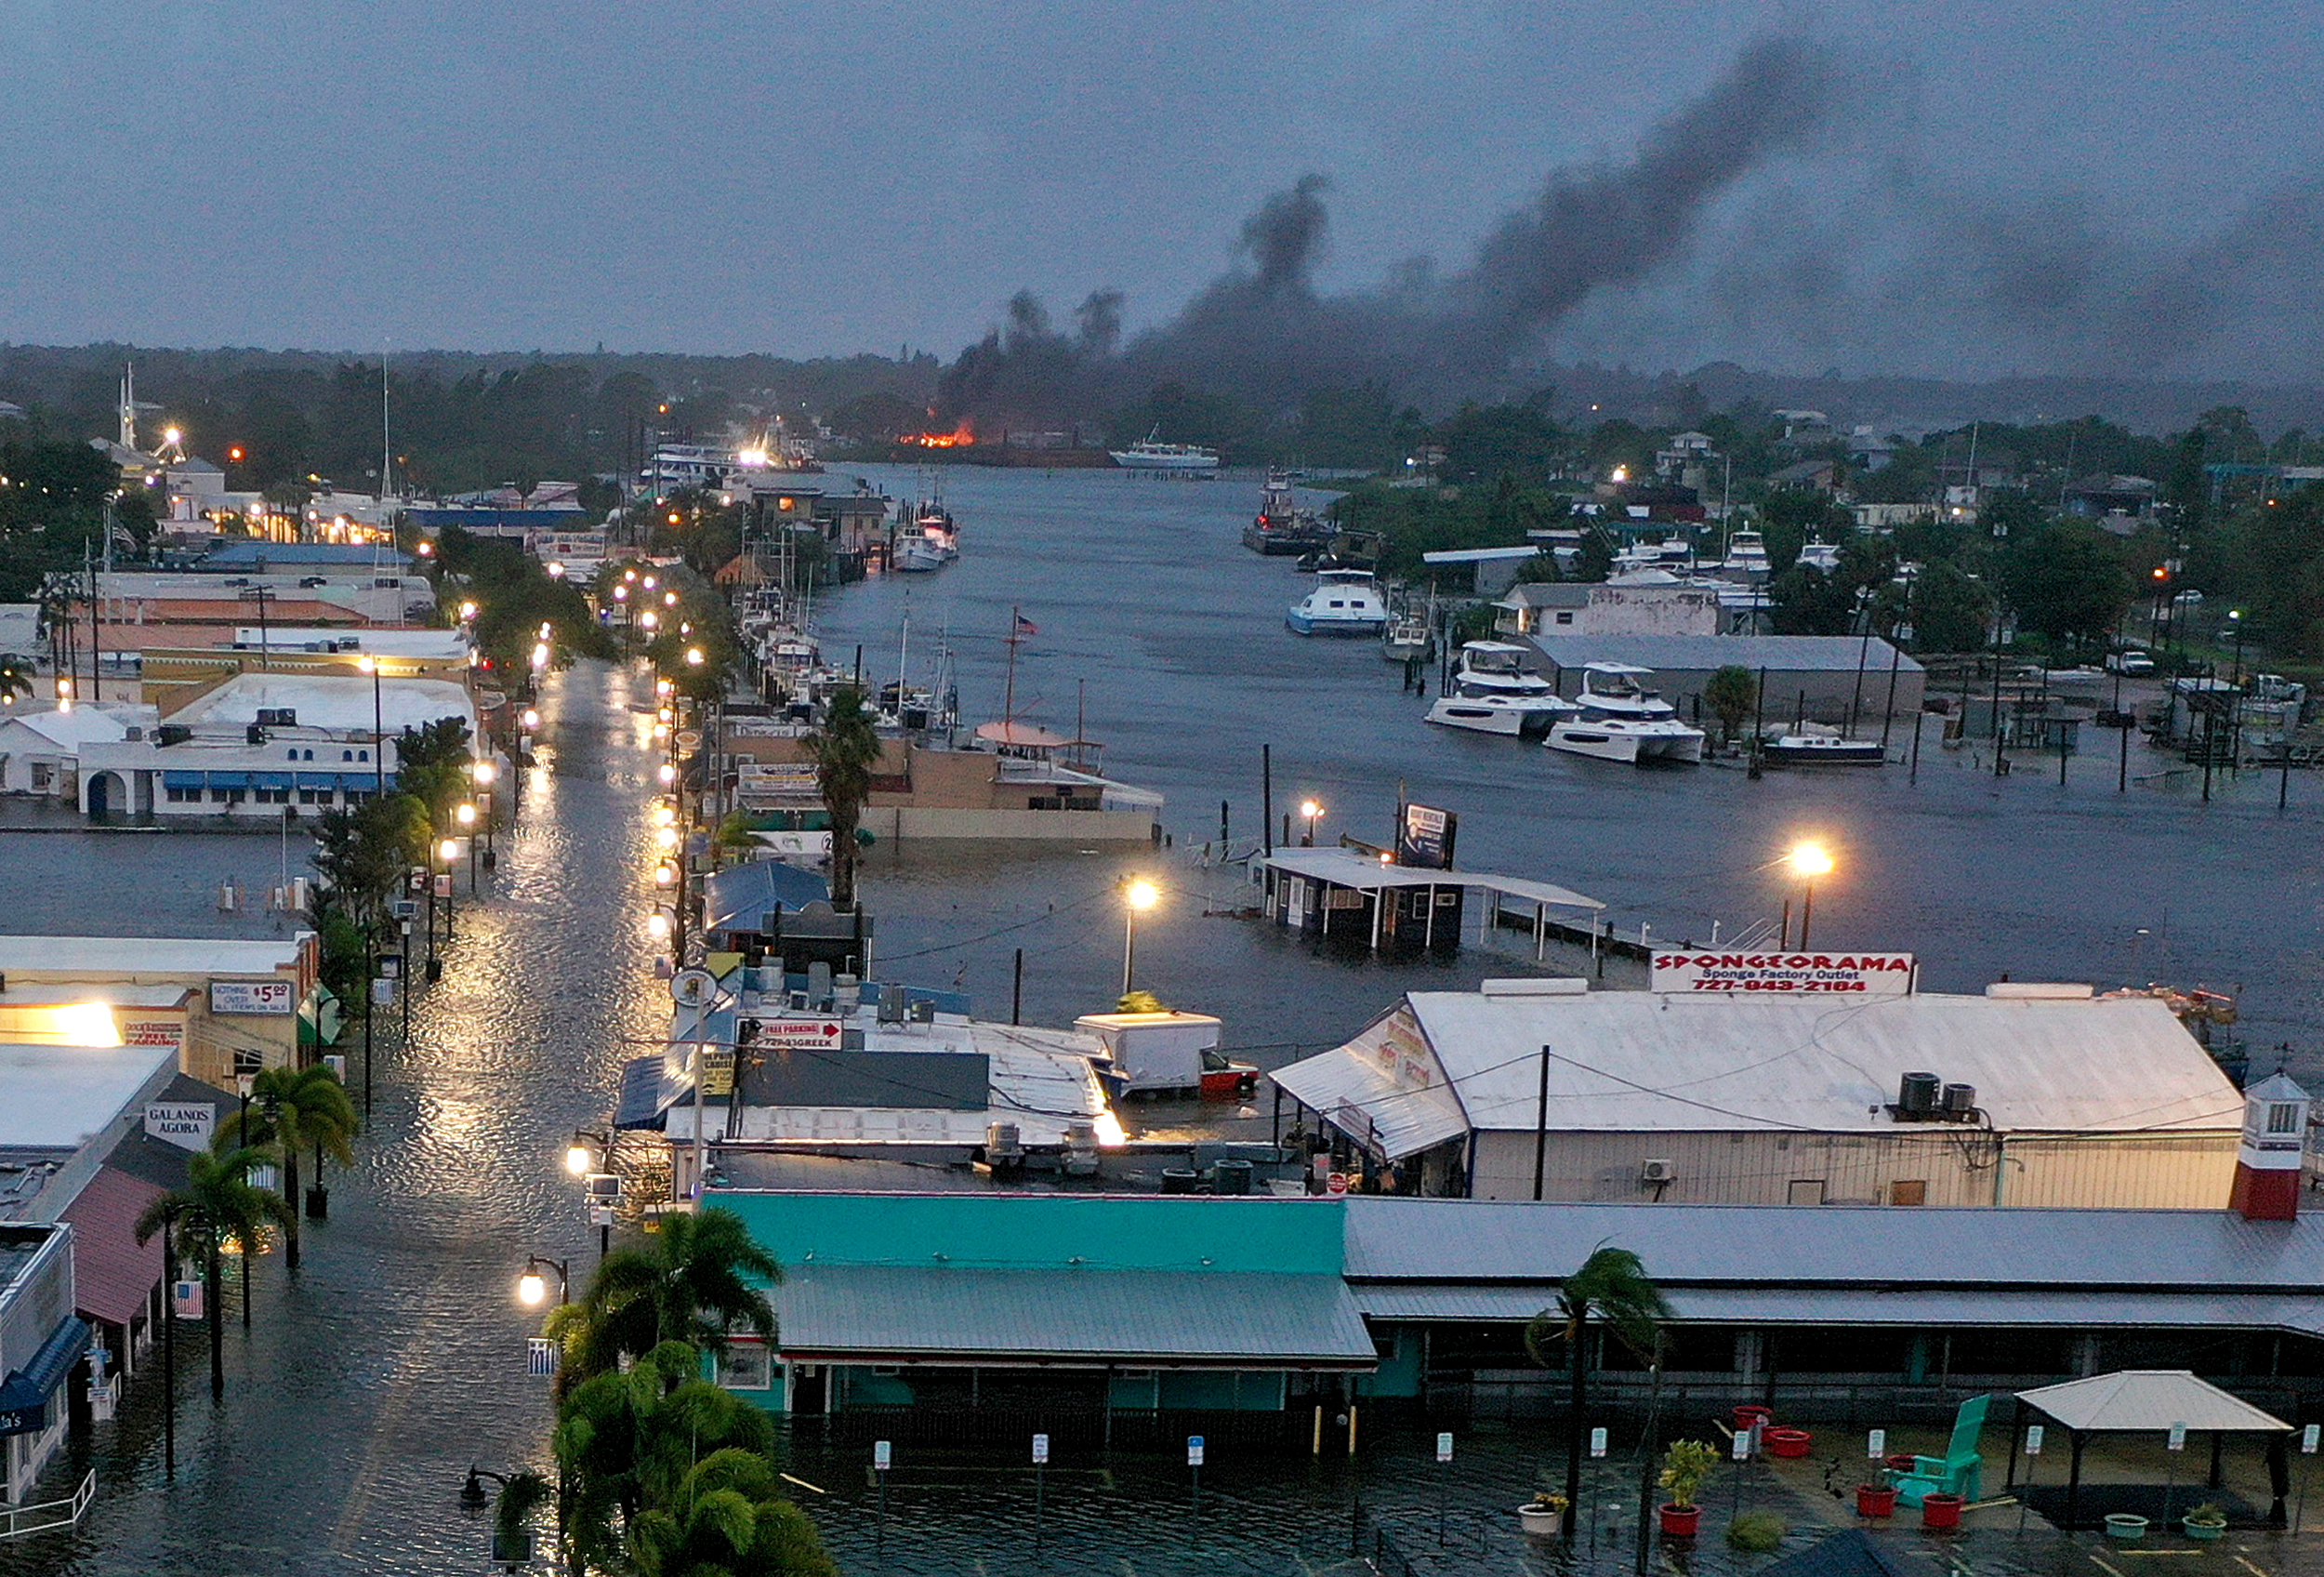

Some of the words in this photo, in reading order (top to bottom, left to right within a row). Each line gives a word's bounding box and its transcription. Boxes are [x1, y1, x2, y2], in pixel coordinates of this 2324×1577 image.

[1655, 954, 1908, 972] SPONGEORAMA
[1702, 969, 1755, 980] Sponge
[1760, 970, 1812, 980] Factory
[1816, 970, 1859, 979] Outlet
[149, 1108, 208, 1120] GALANOS
[159, 1122, 200, 1133] AGORA
